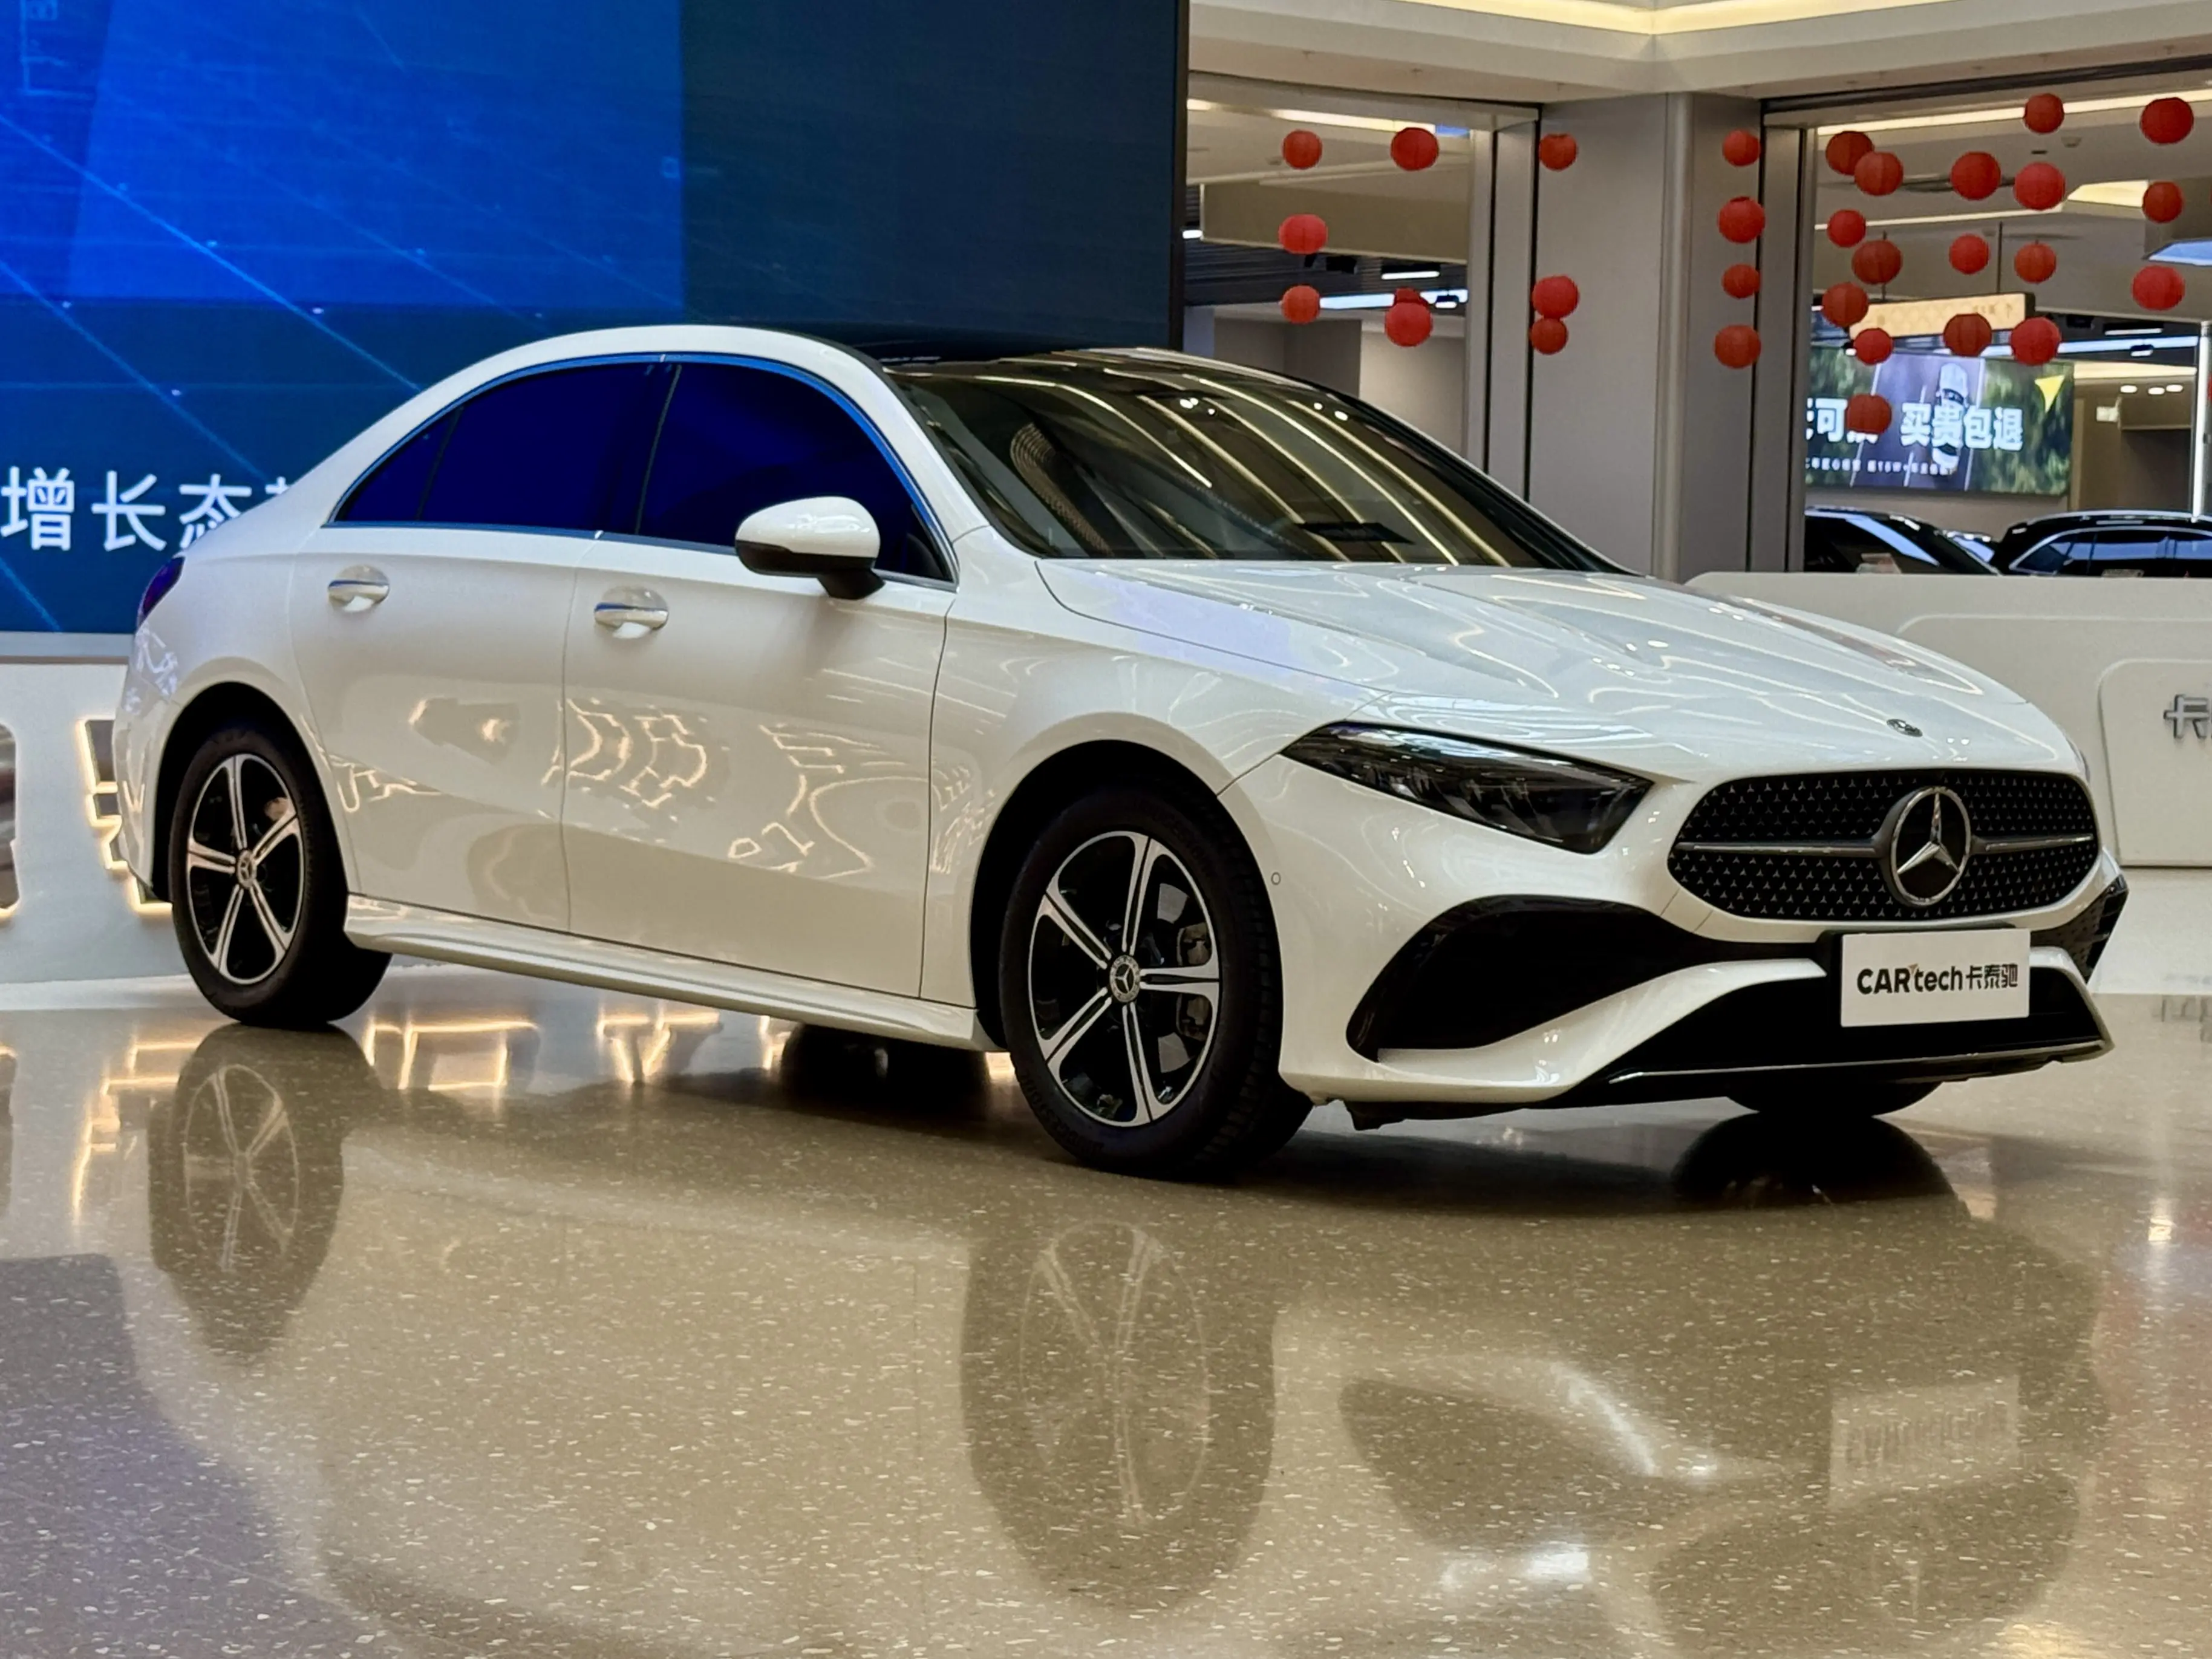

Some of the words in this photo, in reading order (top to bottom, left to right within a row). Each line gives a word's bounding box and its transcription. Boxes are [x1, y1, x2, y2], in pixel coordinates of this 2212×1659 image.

[1806, 398, 1879, 444] 河
[1900, 402, 2023, 451] 买贵包退
[1, 466, 289, 551] 增长态
[1857, 966, 1963, 995] CARtech
[1966, 963, 2018, 990] 卡泰驰
